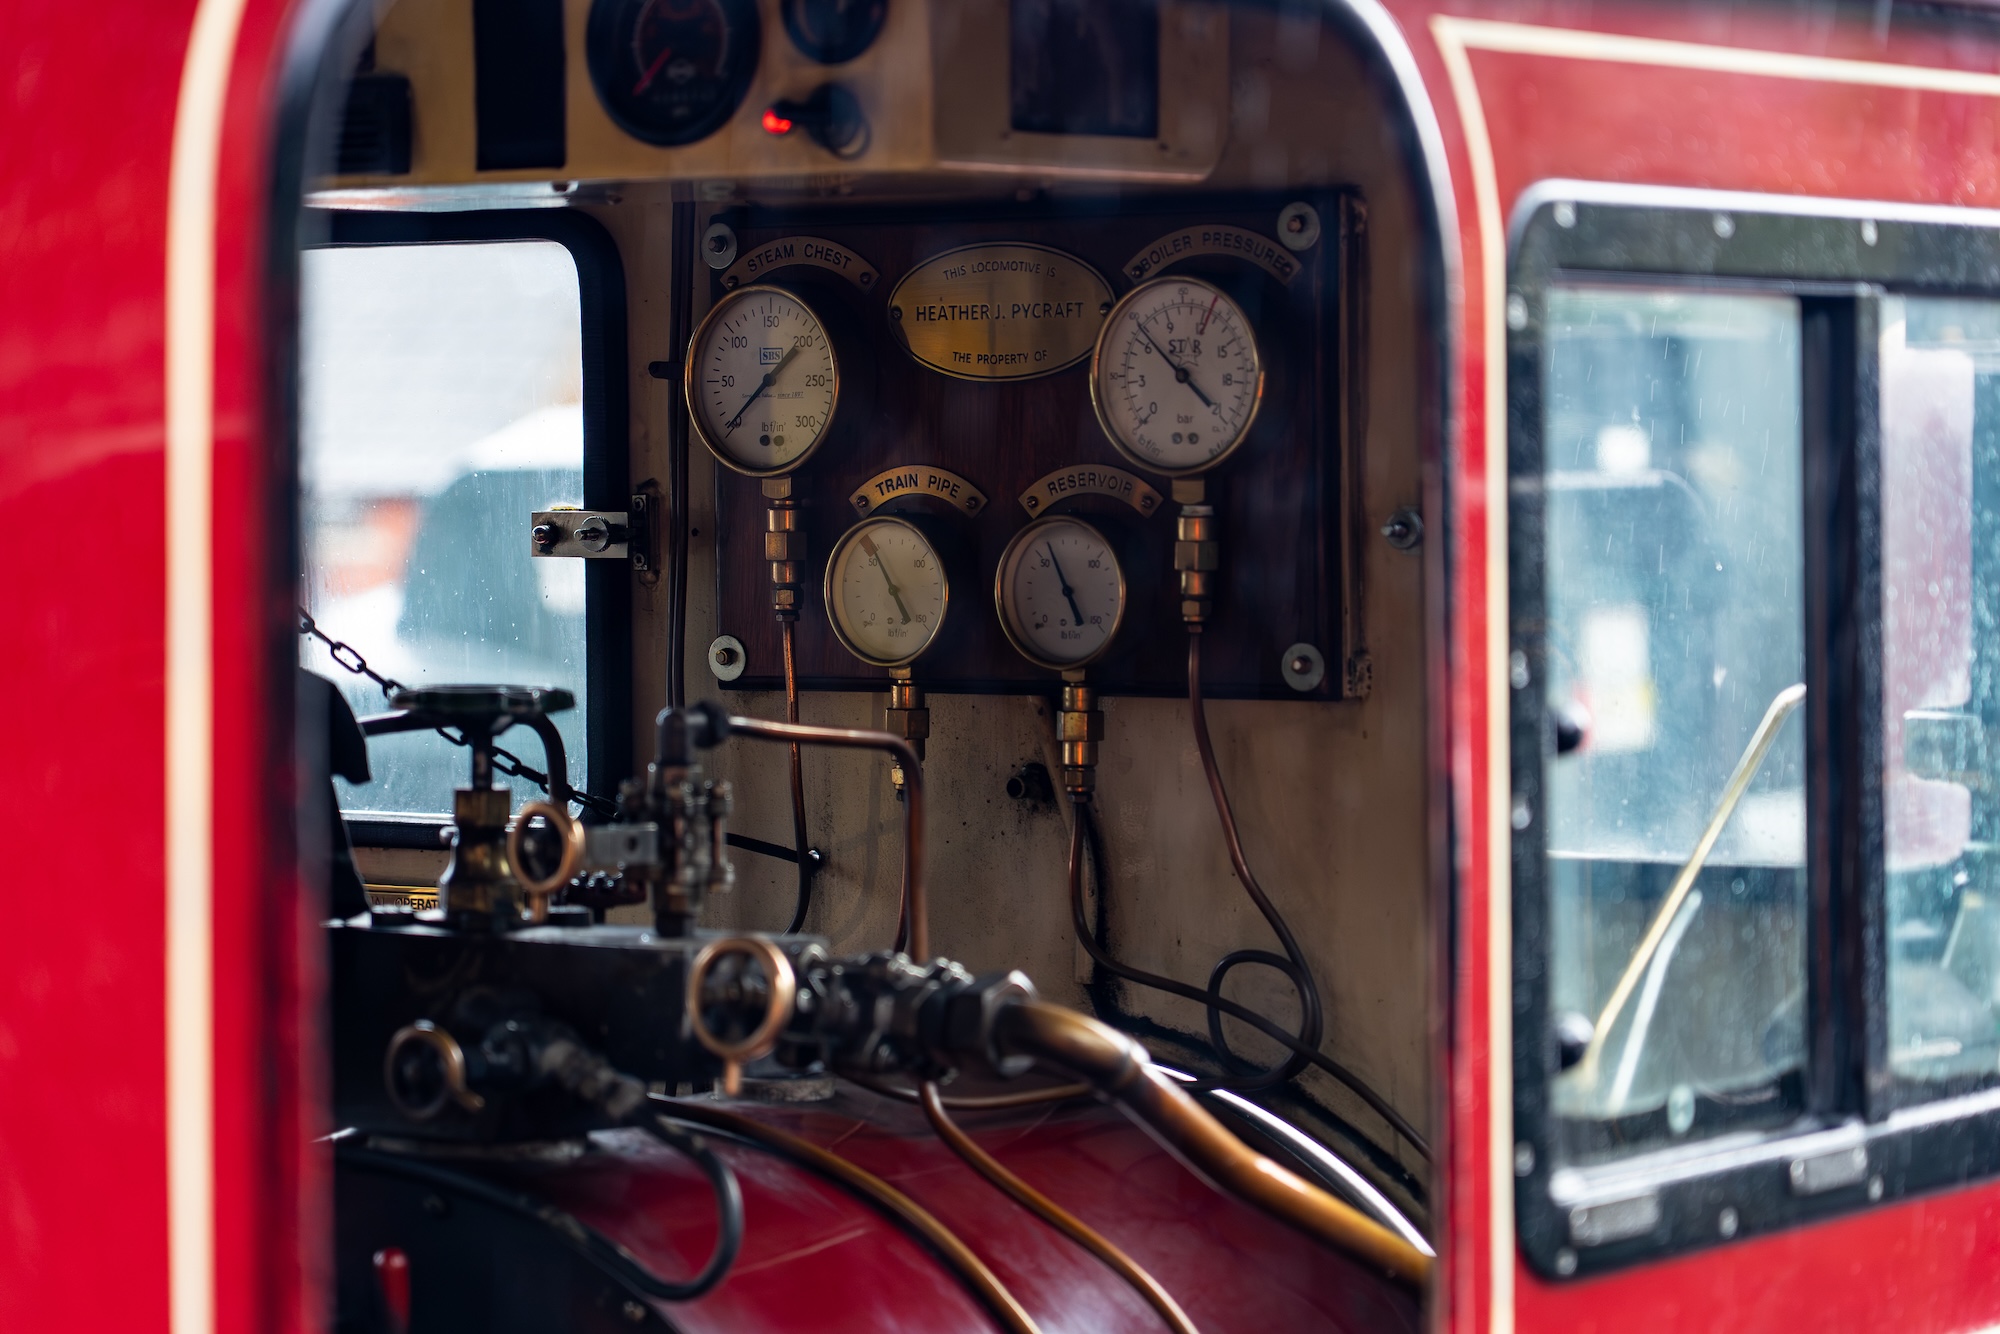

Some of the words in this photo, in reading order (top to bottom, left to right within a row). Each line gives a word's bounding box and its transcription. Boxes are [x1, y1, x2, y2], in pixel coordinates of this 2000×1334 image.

[747, 244, 794, 272] STEAM
[804, 244, 851, 269] CHEST
[1140, 235, 1192, 272] BOILER
[1202, 232, 1285, 270] PRESSURE
[943, 264, 966, 280] THIS
[972, 260, 1041, 274] LOCOMOTIVE
[1046, 267, 1056, 277] IS
[916, 304, 990, 321] HEATHER
[994, 304, 1006, 320] J.
[1012, 302, 1083, 319] PYCRAFT
[763, 316, 780, 328] 150
[1166, 322, 1174, 334] 9
[731, 336, 748, 348] 100
[794, 336, 812, 348] 200
[1144, 343, 1152, 354] 6
[1218, 346, 1228, 358] 15
[762, 350, 780, 361] SBS
[953, 351, 971, 364] THE
[977, 351, 1029, 364] PROPERTY
[1034, 350, 1047, 361] OF
[721, 376, 735, 388] 50
[806, 374, 825, 387] 250
[1138, 375, 1146, 388] 3
[1222, 374, 1233, 386] 18
[1150, 402, 1158, 414] 0
[795, 415, 816, 428] 300
[1177, 414, 1193, 424] bar
[875, 473, 918, 496] TRAIN
[928, 475, 961, 498] PIPE
[1048, 473, 1132, 496] RESERVOIR
[868, 558, 878, 566] 50
[914, 560, 925, 568] 100
[1040, 559, 1050, 568] 50
[1088, 560, 1100, 568] 100
[870, 612, 876, 620] 0
[915, 614, 927, 623] 150
[1042, 614, 1048, 623] 0
[1090, 616, 1102, 624] 150
